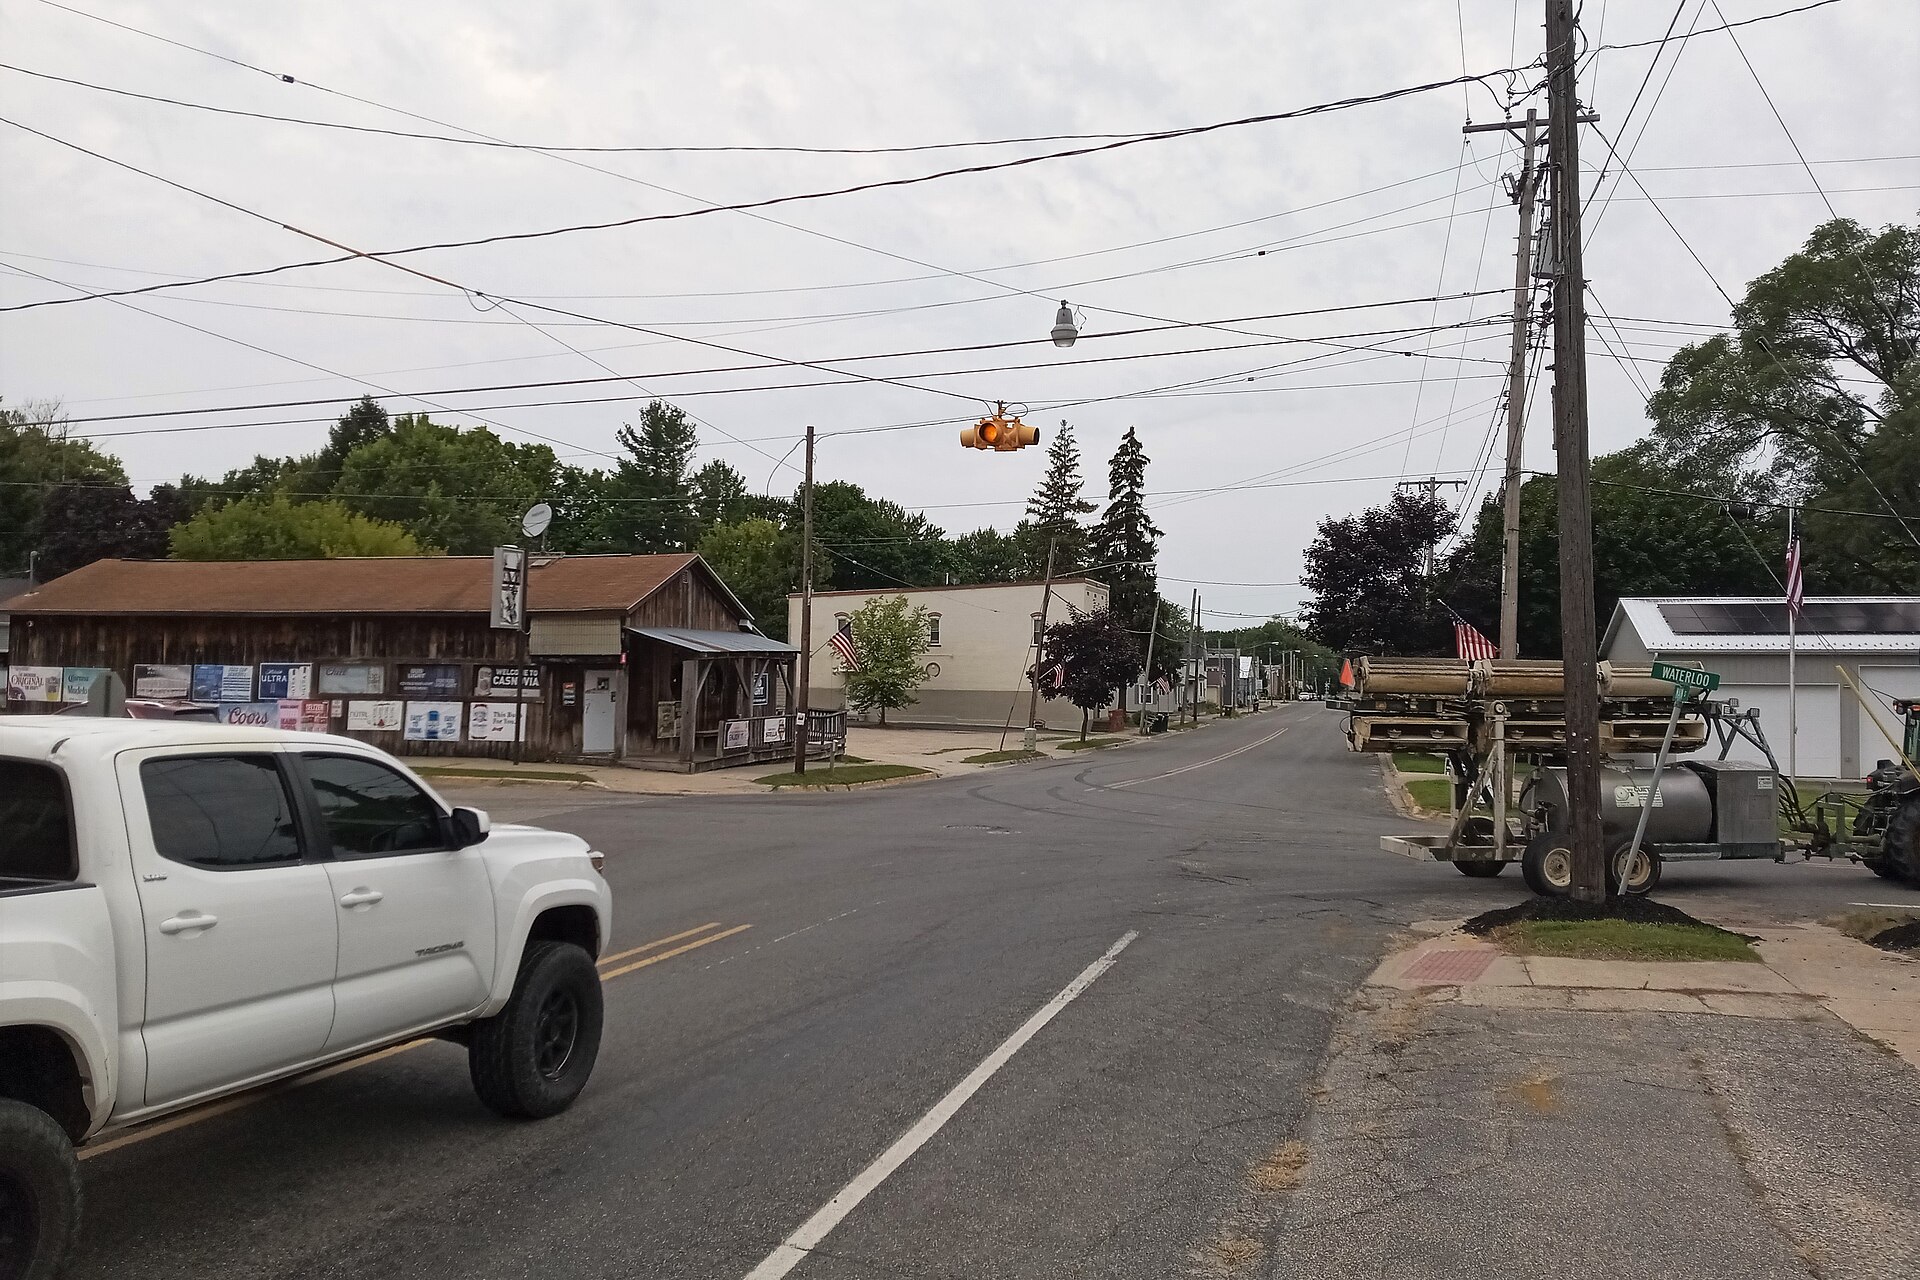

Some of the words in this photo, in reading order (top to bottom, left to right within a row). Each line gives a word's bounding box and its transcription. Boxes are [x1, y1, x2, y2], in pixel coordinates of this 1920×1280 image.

[496, 668, 528, 676] WELCOE
[1662, 666, 1710, 687] WATERLOO
[11, 675, 44, 687] ORIGINAL
[261, 674, 287, 682] ULTRA
[493, 676, 540, 686] CASNVIA
[227, 706, 268, 726] Coors
